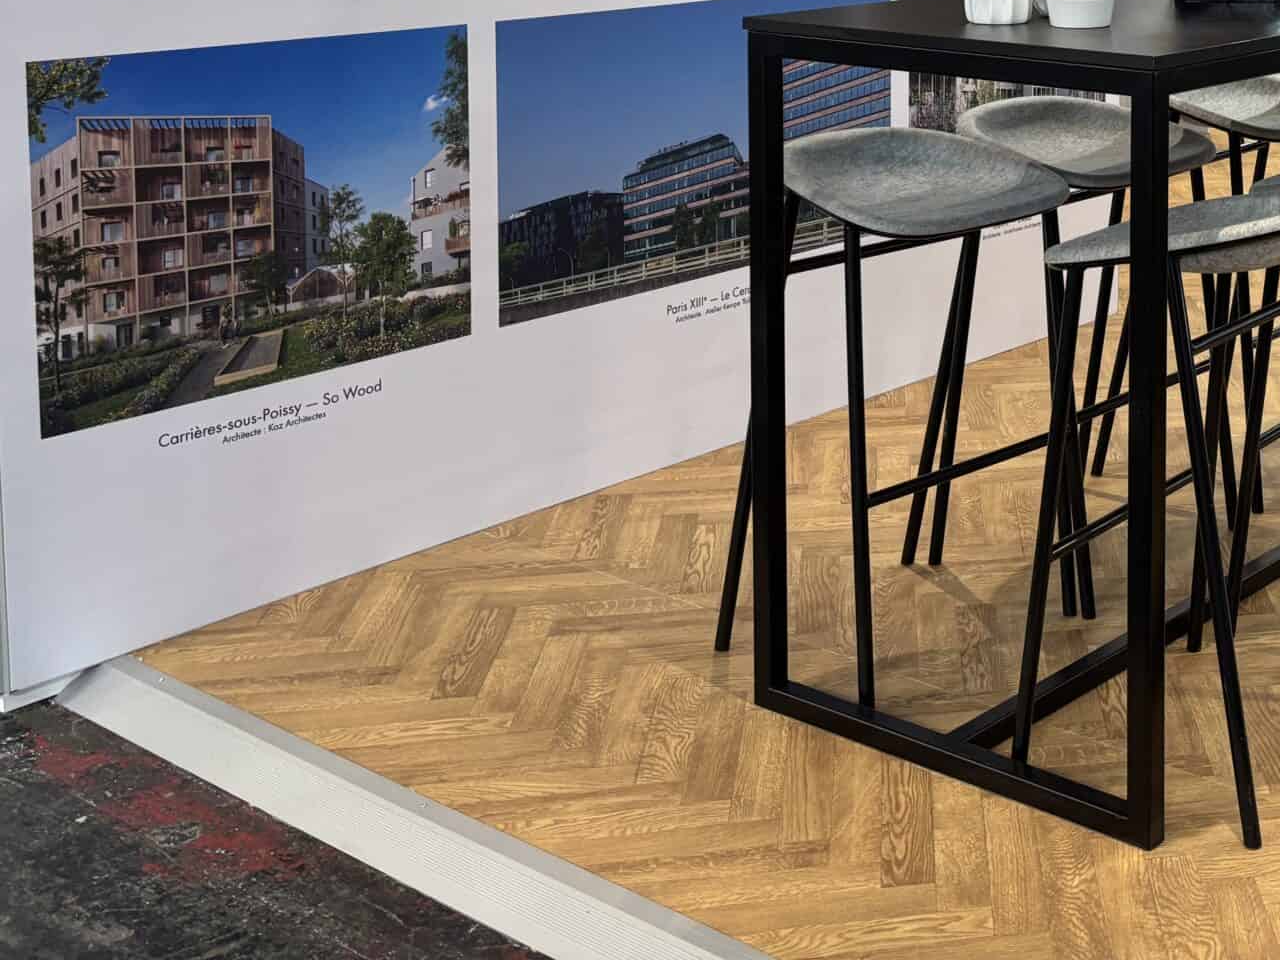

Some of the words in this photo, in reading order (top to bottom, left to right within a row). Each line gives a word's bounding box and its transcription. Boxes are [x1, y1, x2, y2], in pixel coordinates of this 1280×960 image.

[667, 302, 688, 315] Paris
[721, 290, 730, 301] Le
[158, 403, 303, 448] Carrières-sous-Poissy
[322, 392, 339, 406] So
[343, 378, 383, 401] Wood
[222, 428, 261, 444] Architecte
[285, 411, 327, 428] Architectes
